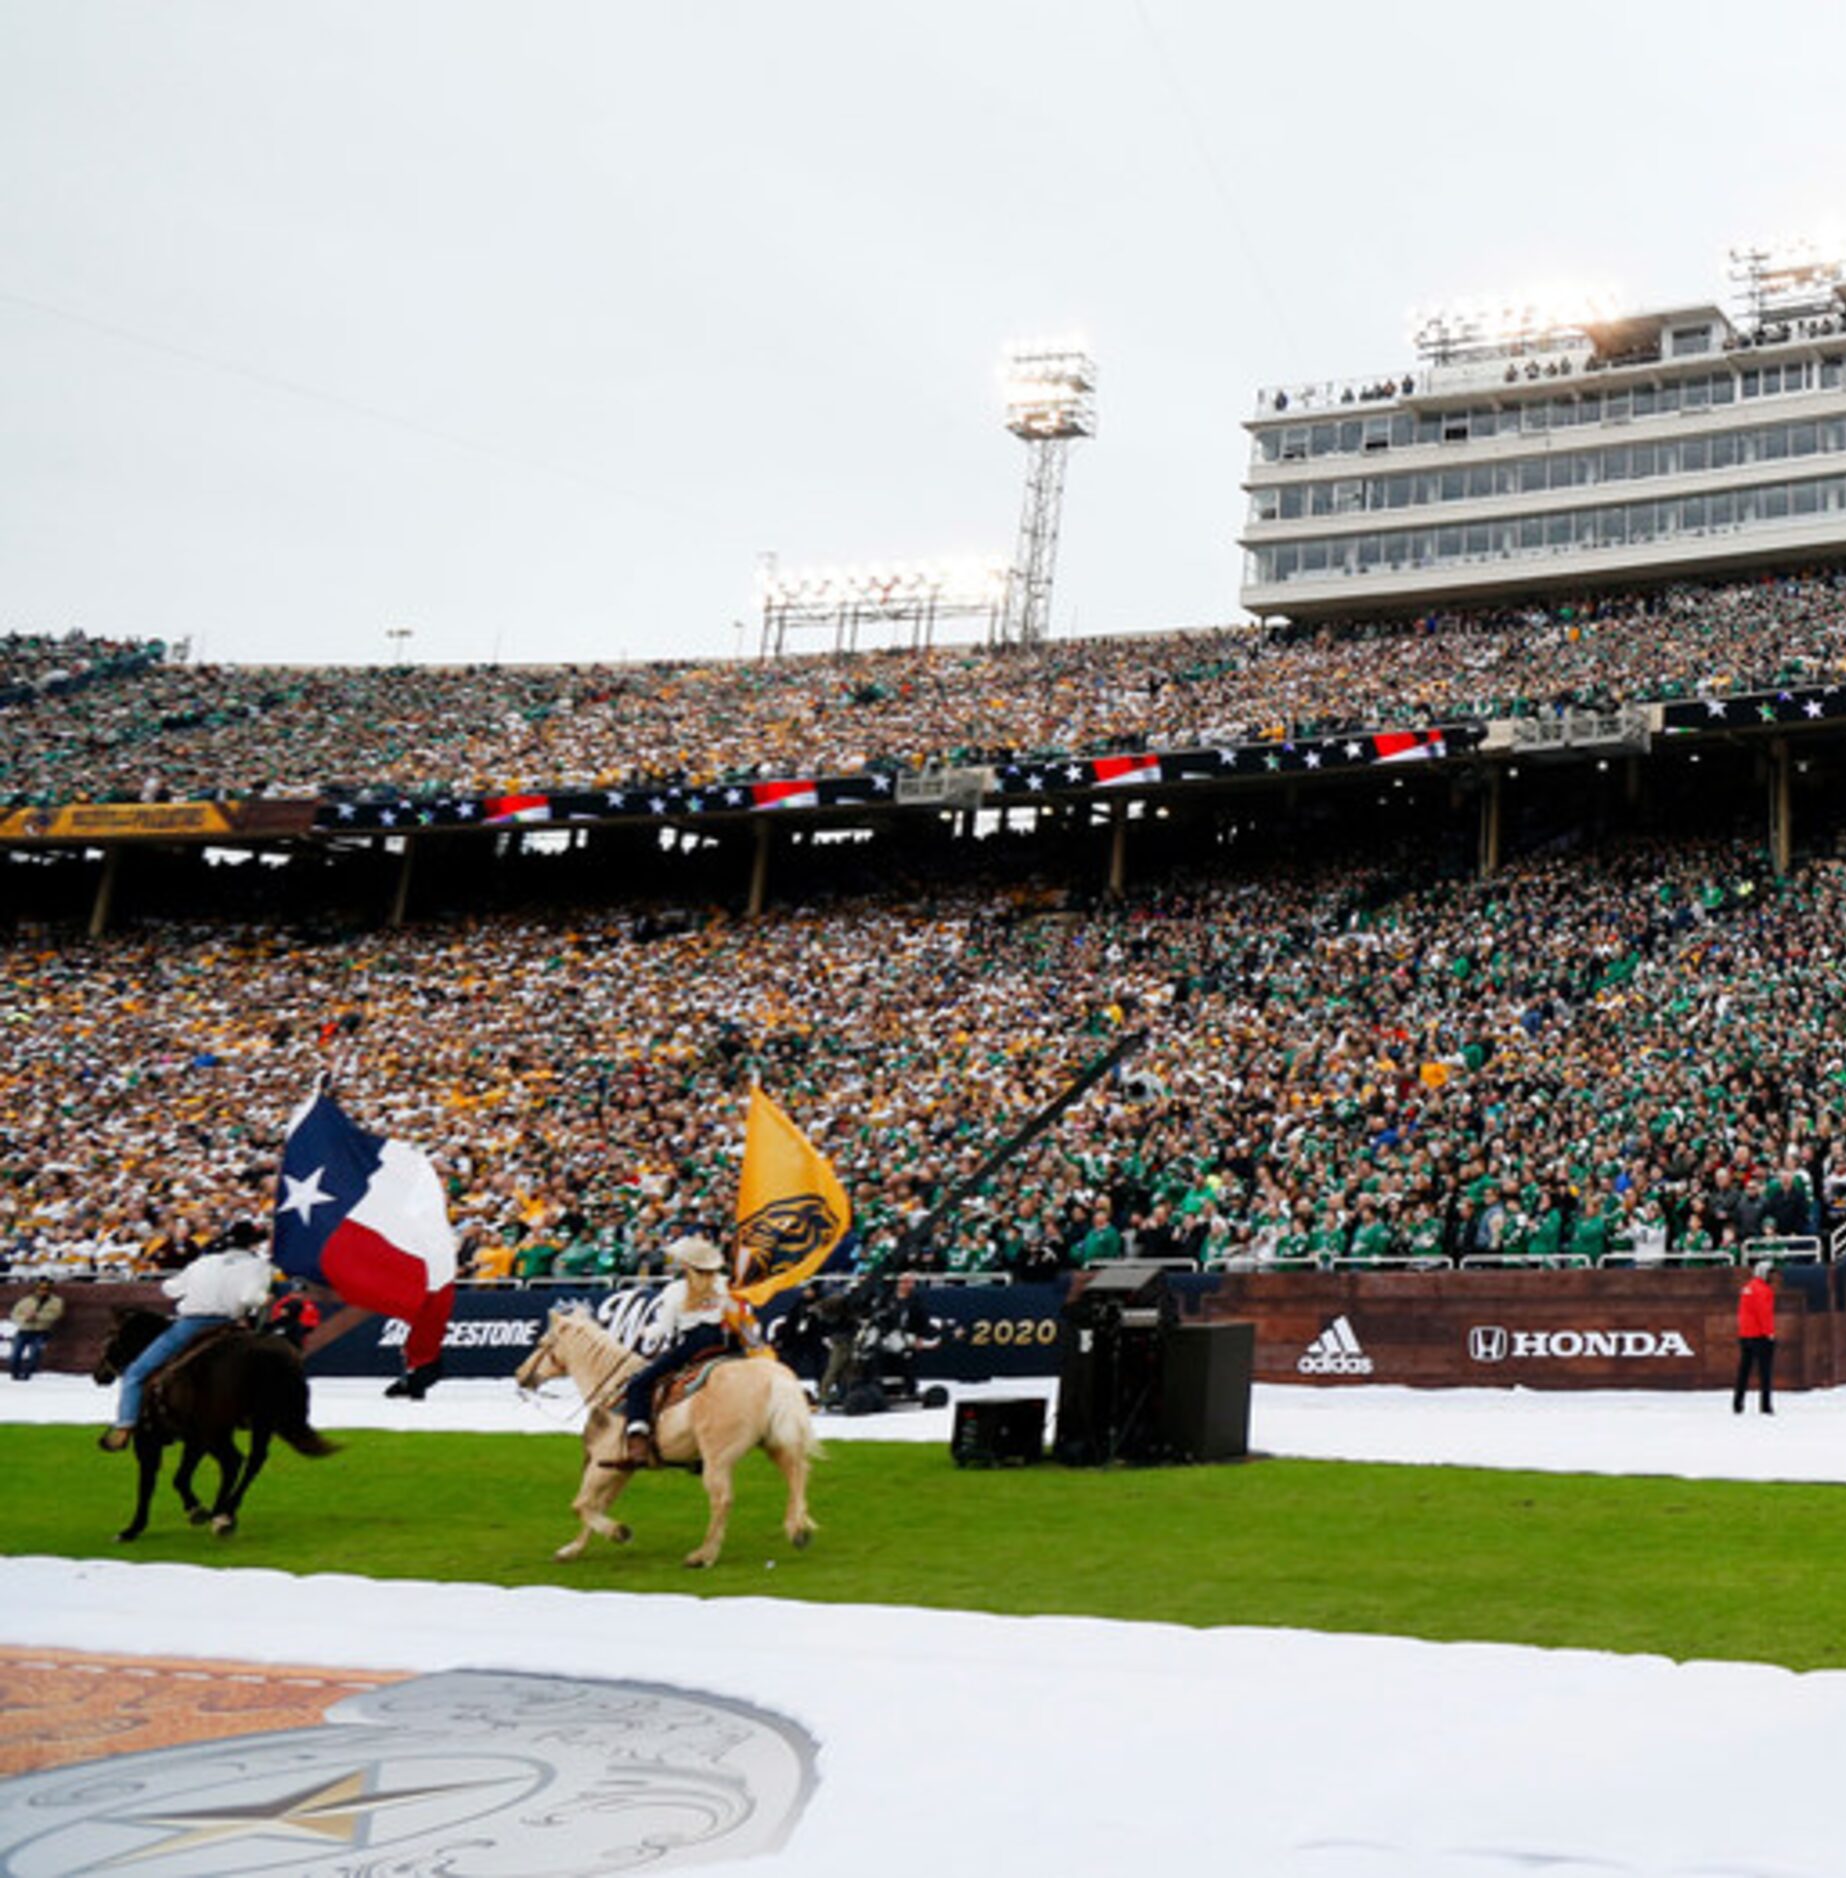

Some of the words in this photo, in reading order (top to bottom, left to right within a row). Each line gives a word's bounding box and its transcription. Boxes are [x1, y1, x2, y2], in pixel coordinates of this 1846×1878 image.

[971, 1319, 1058, 1346] 2020
[1511, 1331, 1695, 1357] HONDA
[1297, 1354, 1374, 1375] adidas
